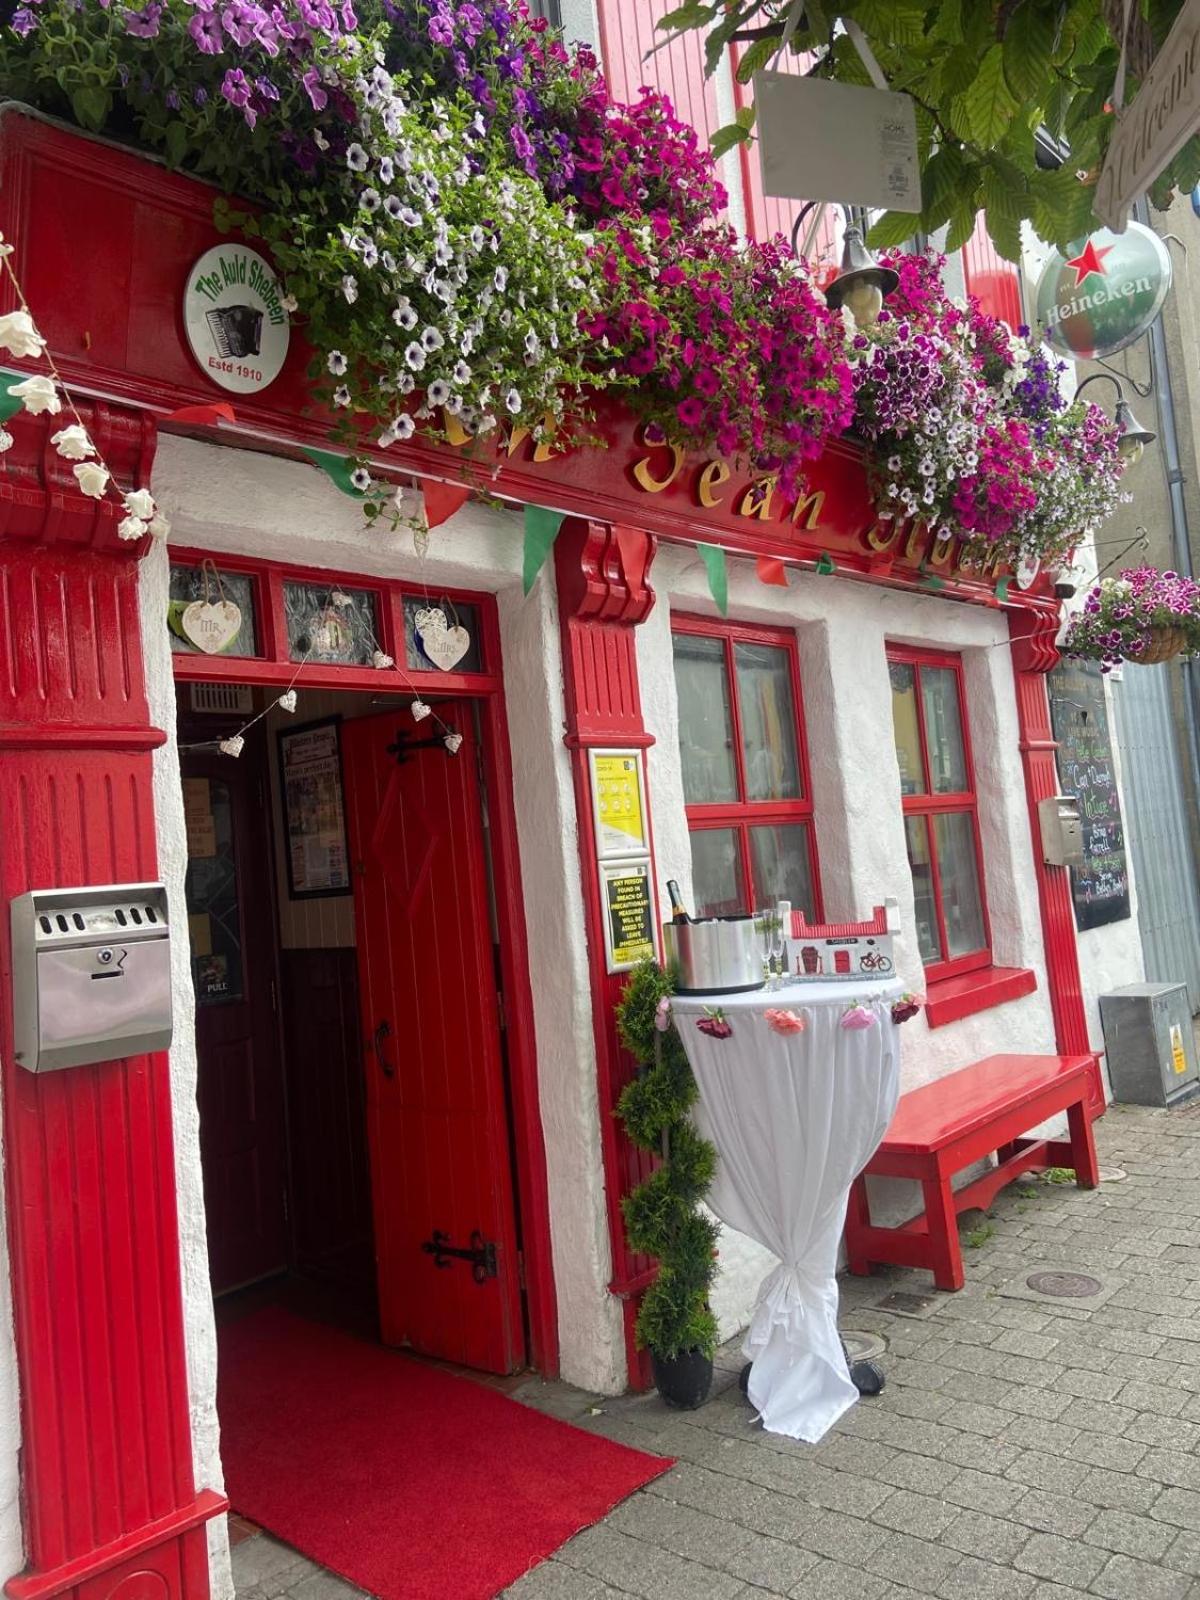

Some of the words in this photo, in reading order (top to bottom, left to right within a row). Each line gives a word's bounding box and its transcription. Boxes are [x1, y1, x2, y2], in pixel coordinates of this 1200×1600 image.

[195, 271, 224, 302] The
[219, 254, 247, 288] Auld
[248, 259, 285, 326] Shebeen
[1046, 277, 1152, 326] Heineken
[208, 357, 233, 373] Estd
[236, 366, 262, 382] 1910
[634, 421, 826, 530] Sean
[207, 982, 229, 993] PULL
